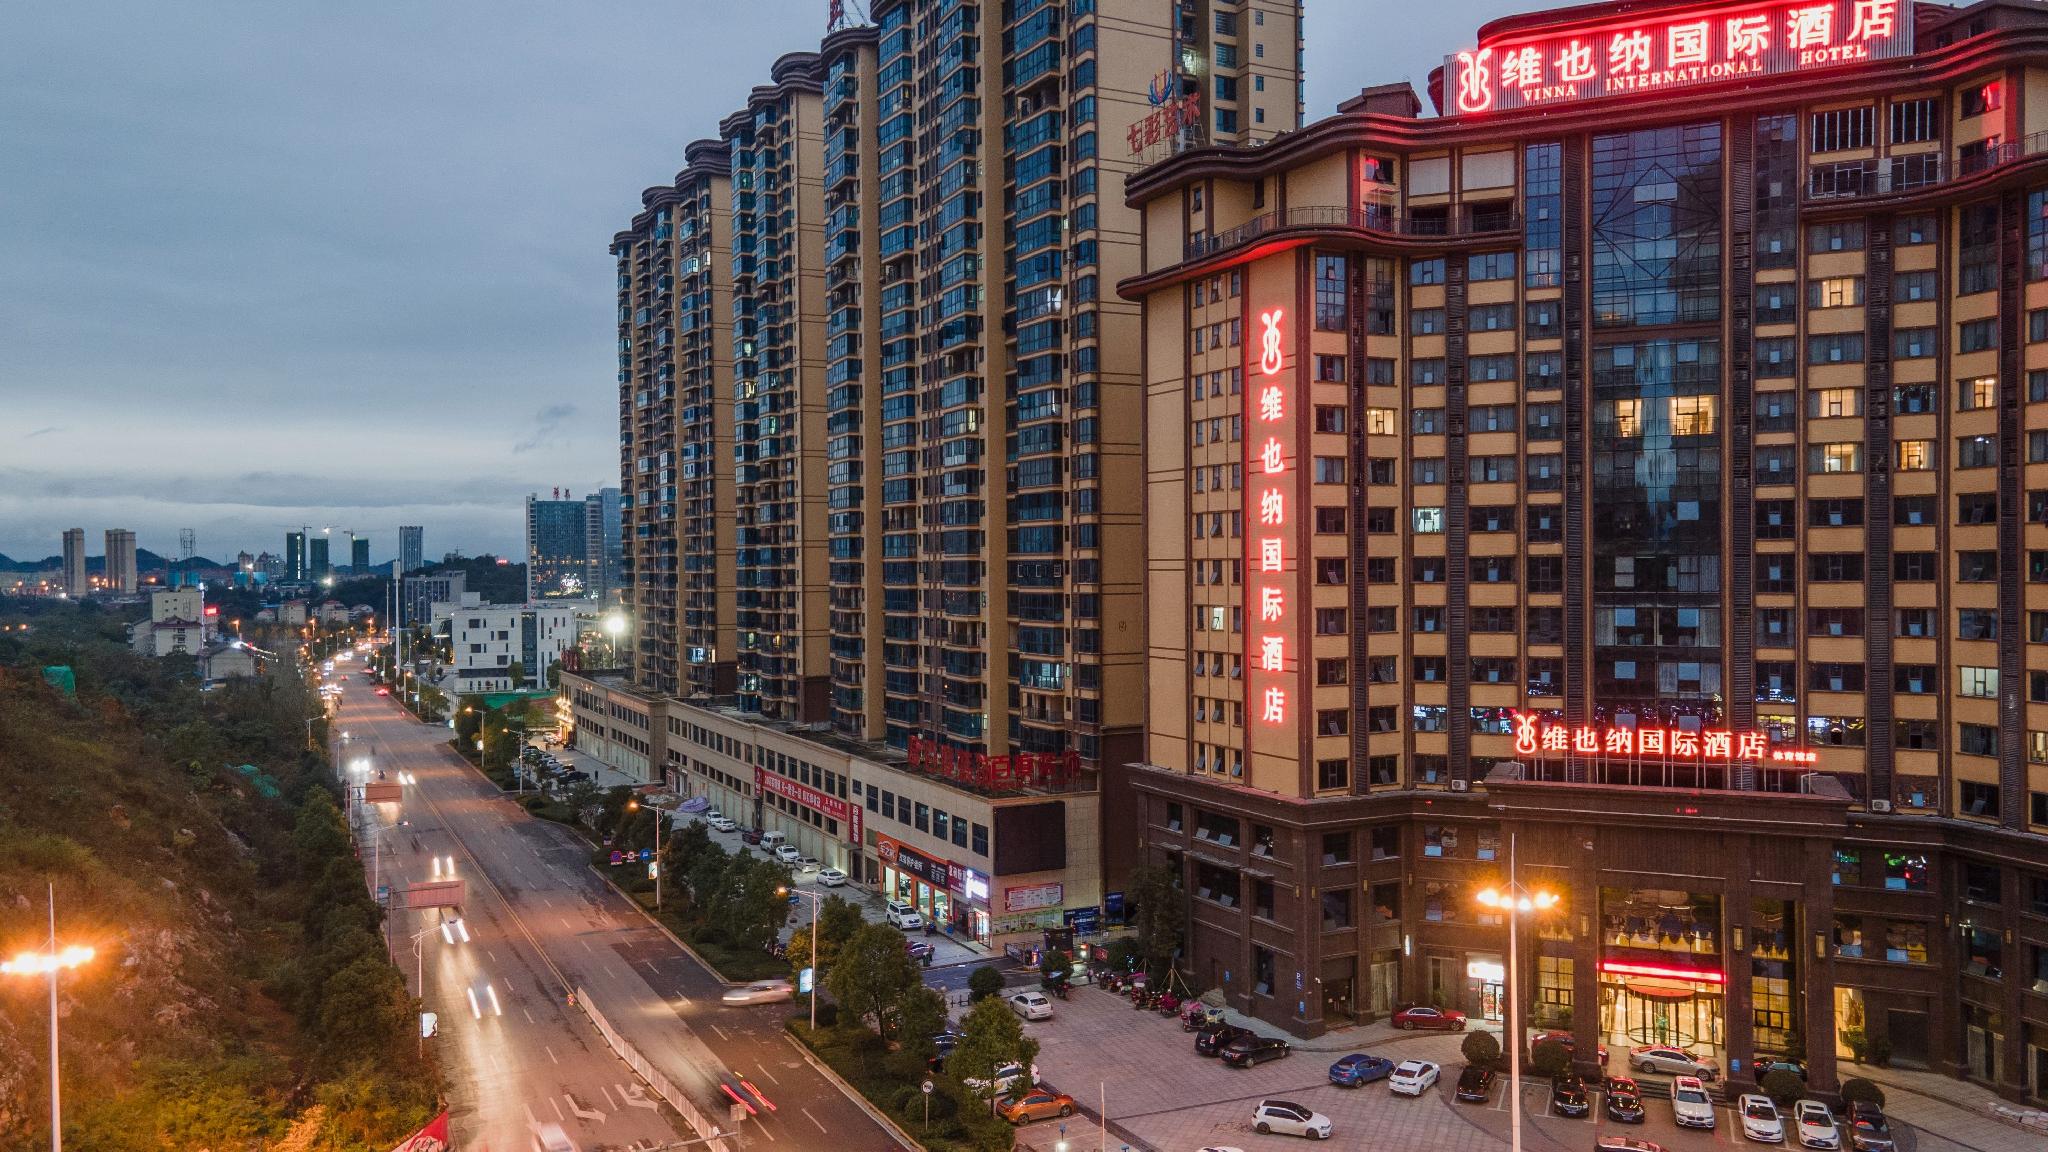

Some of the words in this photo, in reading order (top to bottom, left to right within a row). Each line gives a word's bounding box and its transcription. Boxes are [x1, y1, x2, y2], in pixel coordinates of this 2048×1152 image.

[1501, 0, 1895, 85] 维也纳国际酒店
[1523, 84, 1578, 102] VINNA
[1605, 58, 1762, 92] INTERNATIONAL
[1800, 44, 1867, 65] HOTEL
[1260, 386, 1285, 722] 维也纳国际酒店
[1541, 727, 1767, 759] 维也纳国际酒店
